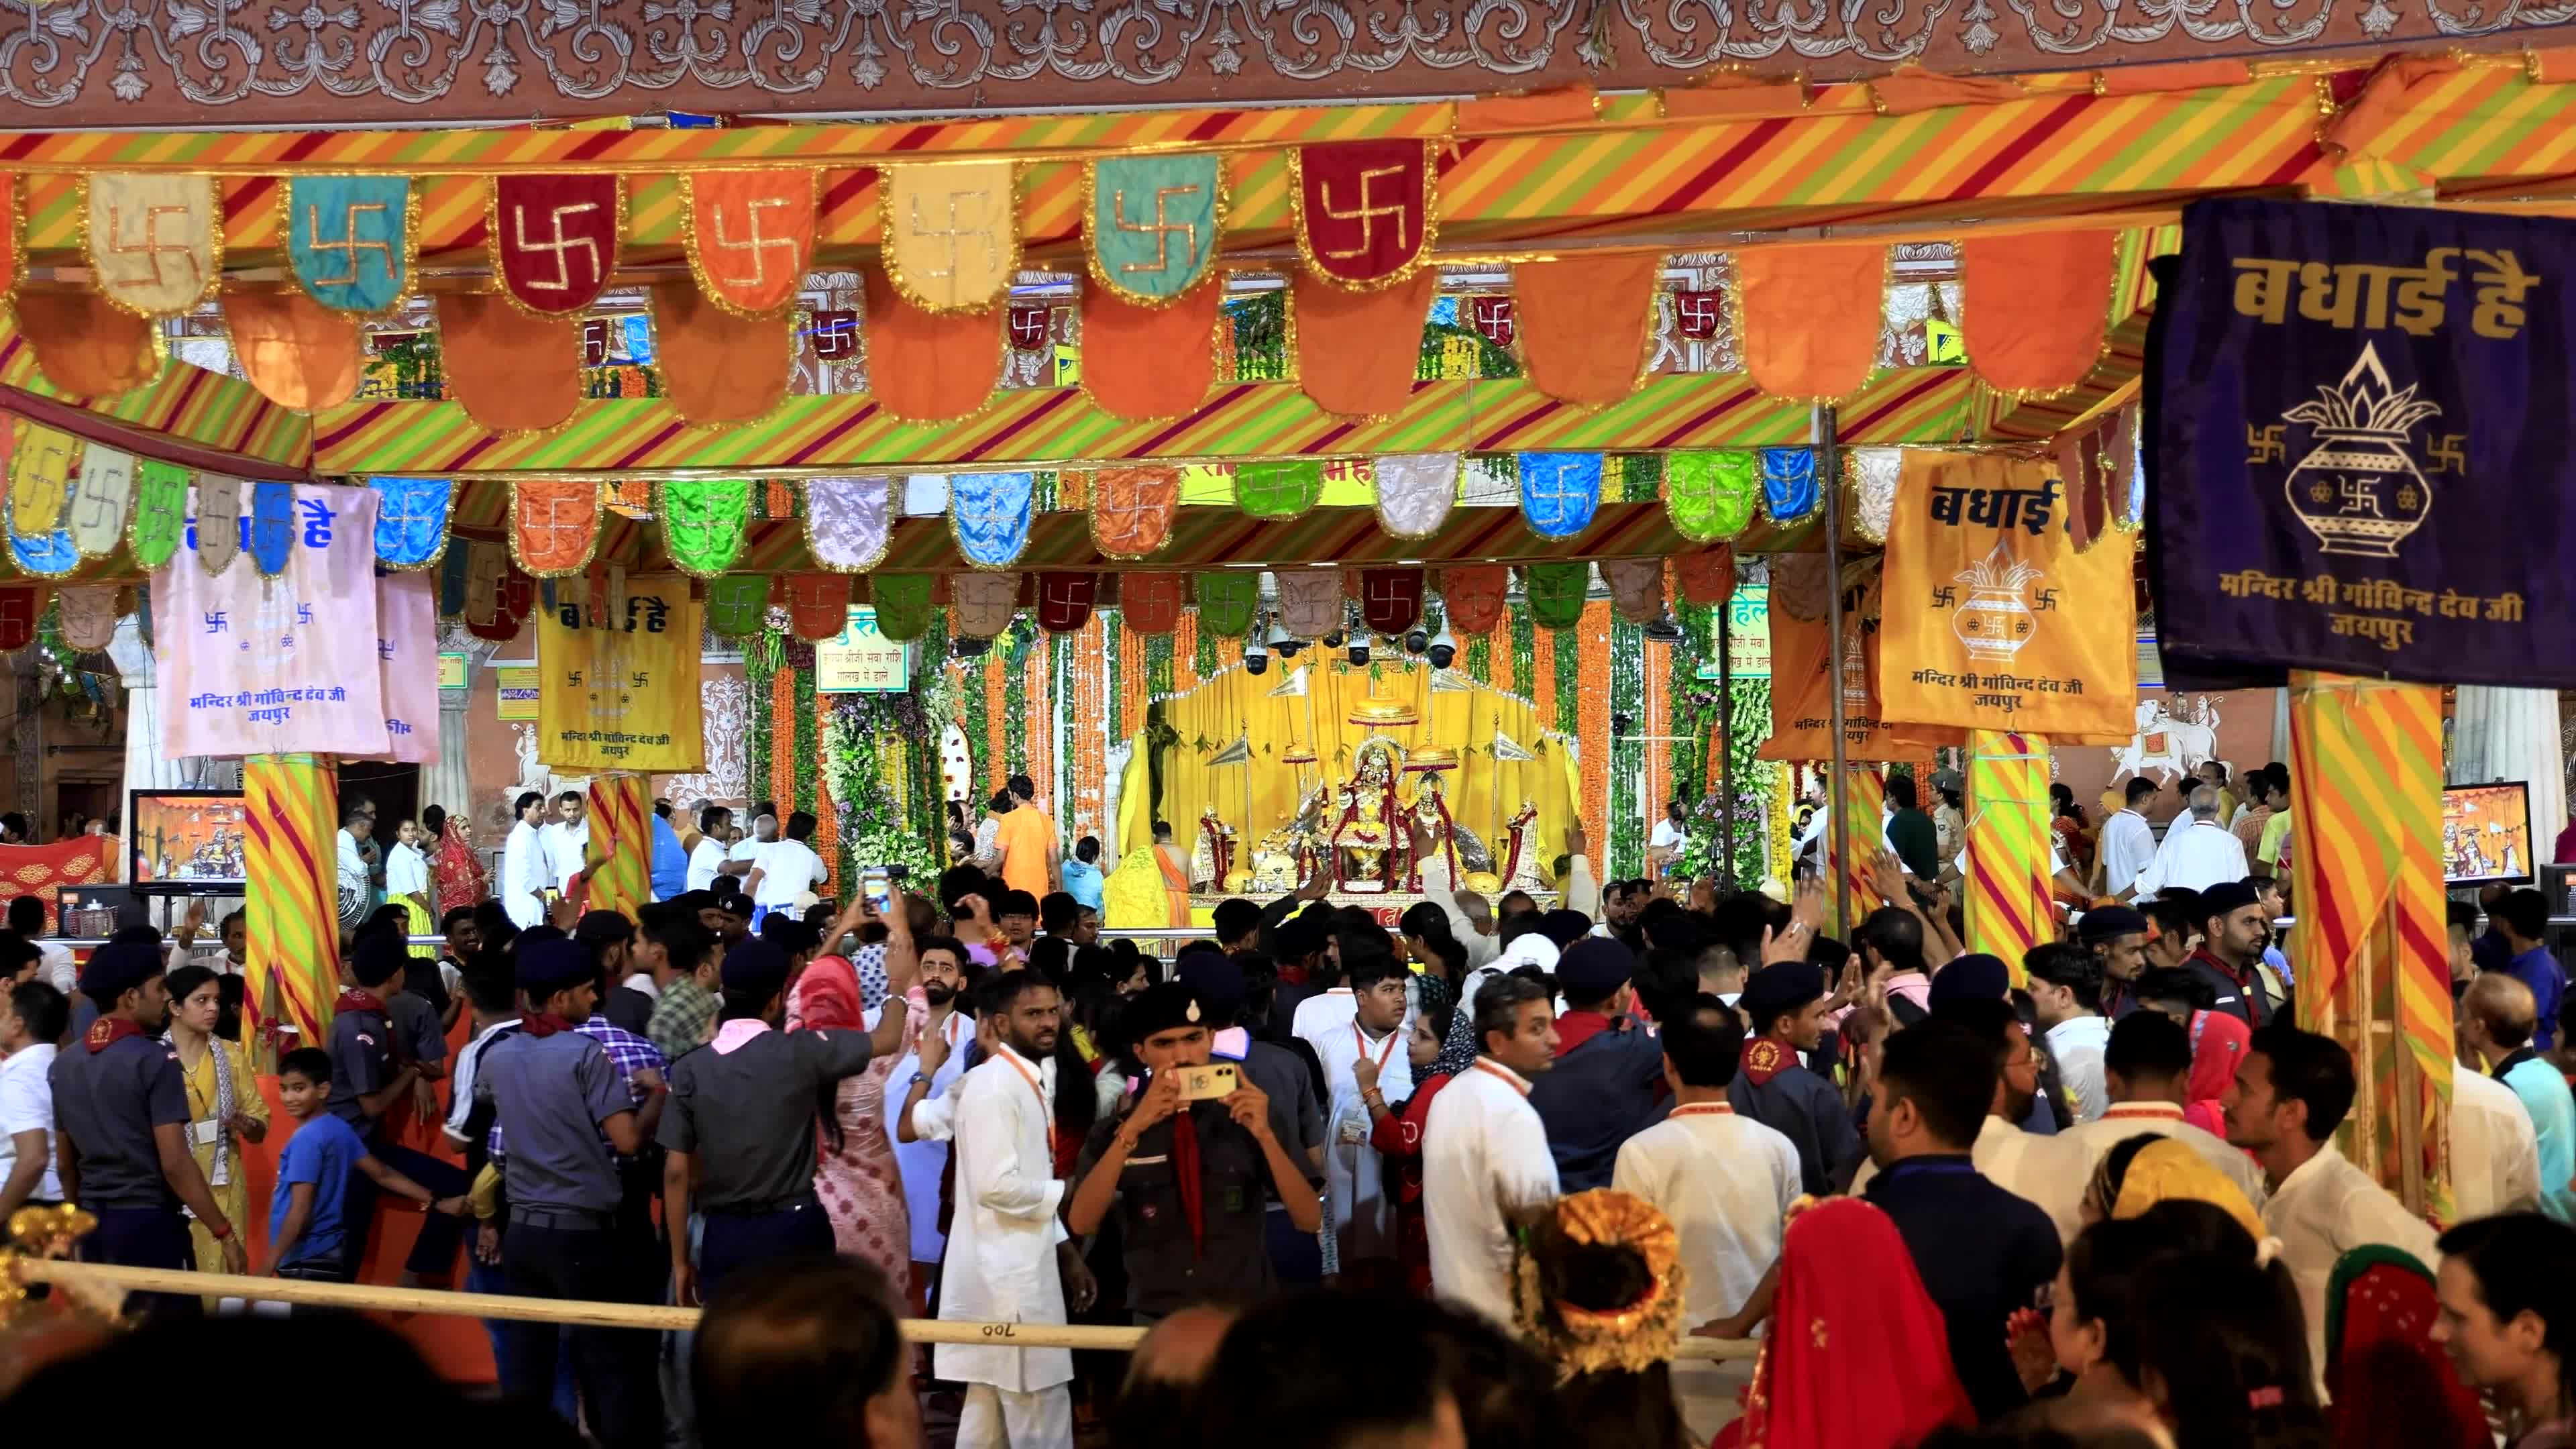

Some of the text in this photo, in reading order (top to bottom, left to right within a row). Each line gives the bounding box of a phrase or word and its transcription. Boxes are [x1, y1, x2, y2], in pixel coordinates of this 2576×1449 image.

[2233, 248, 2540, 339] बधाई है
[1931, 480, 2062, 535] बधाई
[297, 499, 337, 547] है
[2220, 570, 2524, 622] मन्दिर श्री गोविन्द देव जी
[2328, 613, 2413, 649] जयपुर
[1913, 669, 2082, 694] मन्दिर श्री गोविन्द देव जी
[190, 686, 346, 709] मन्दिर श्री गोविन्द देव जी
[1973, 694, 2023, 712] जयपुर
[248, 706, 290, 724] जयपुर
[1794, 718, 1827, 730] मन्दिर
[589, 730, 601, 742] श्री
[1846, 731, 1870, 745] यपुर
